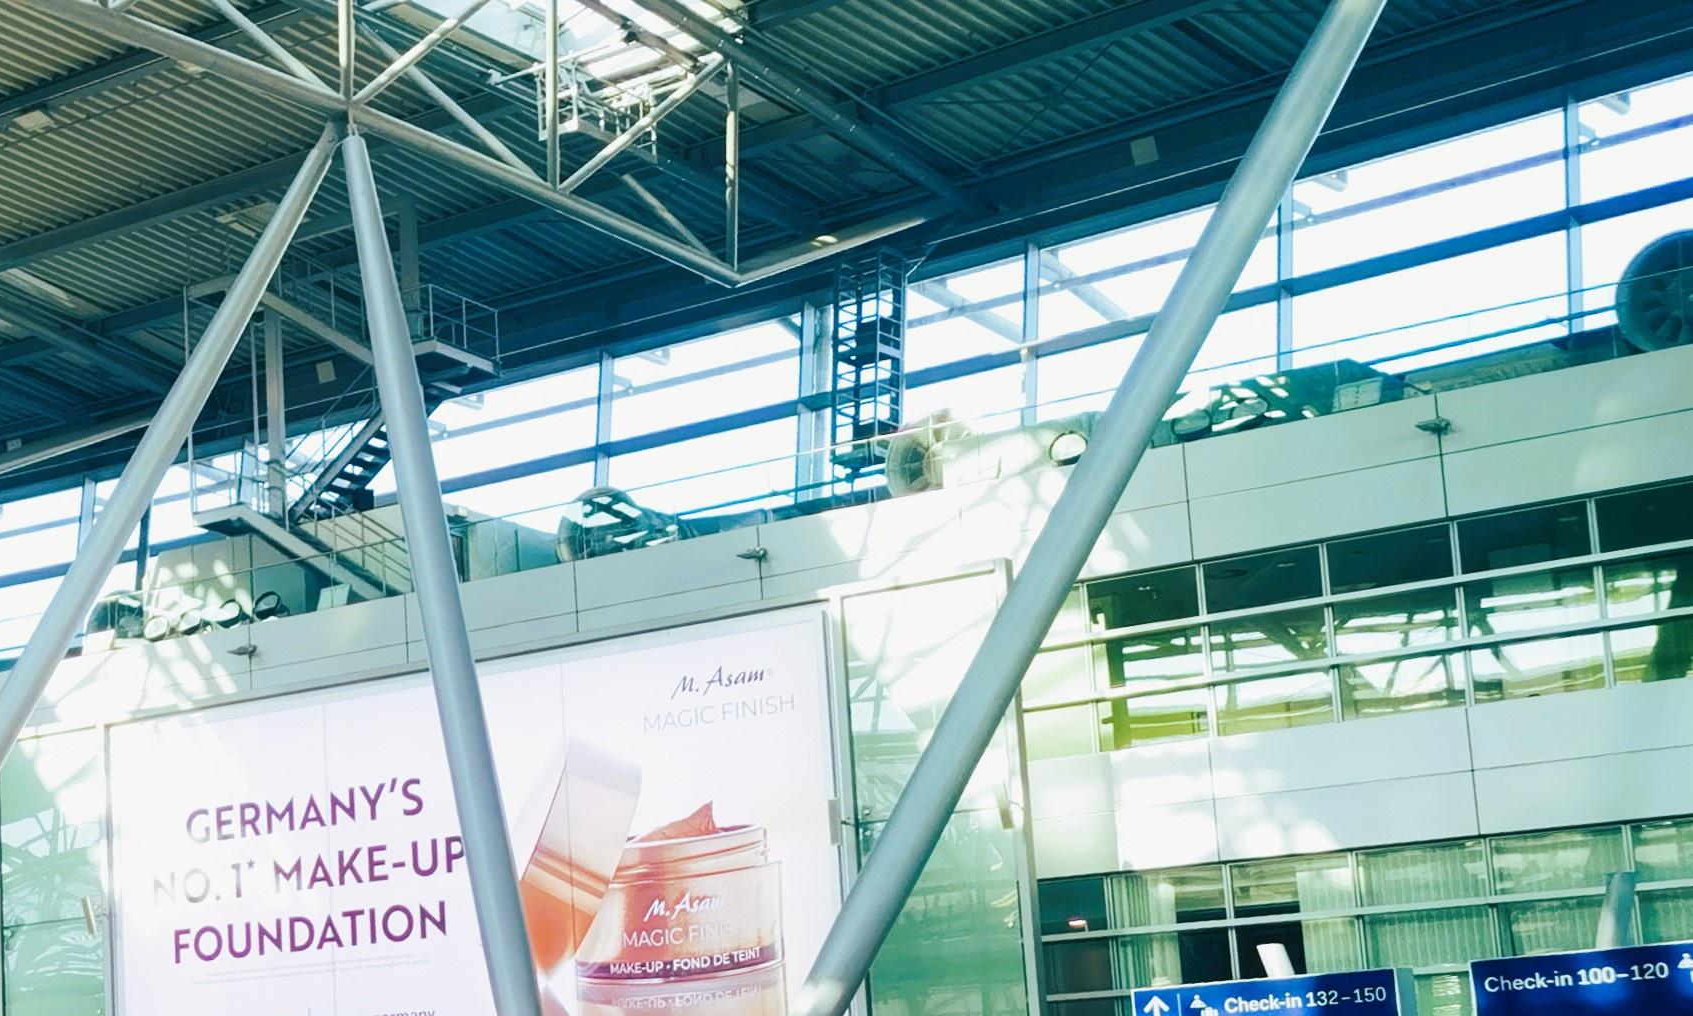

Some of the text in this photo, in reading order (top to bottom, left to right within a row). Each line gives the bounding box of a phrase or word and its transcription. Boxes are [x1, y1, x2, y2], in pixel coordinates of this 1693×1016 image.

[643, 693, 795, 733] MAGIC FINISH
[273, 835, 465, 894] MAKE-UP
[173, 900, 447, 964] FOUNDATION
[622, 927, 684, 948] MAGIC
[609, 946, 761, 975] MAKE-UP FOND DE TEINT
[1484, 969, 1574, 993] Check-in
[1224, 991, 1303, 1014] Check-in
